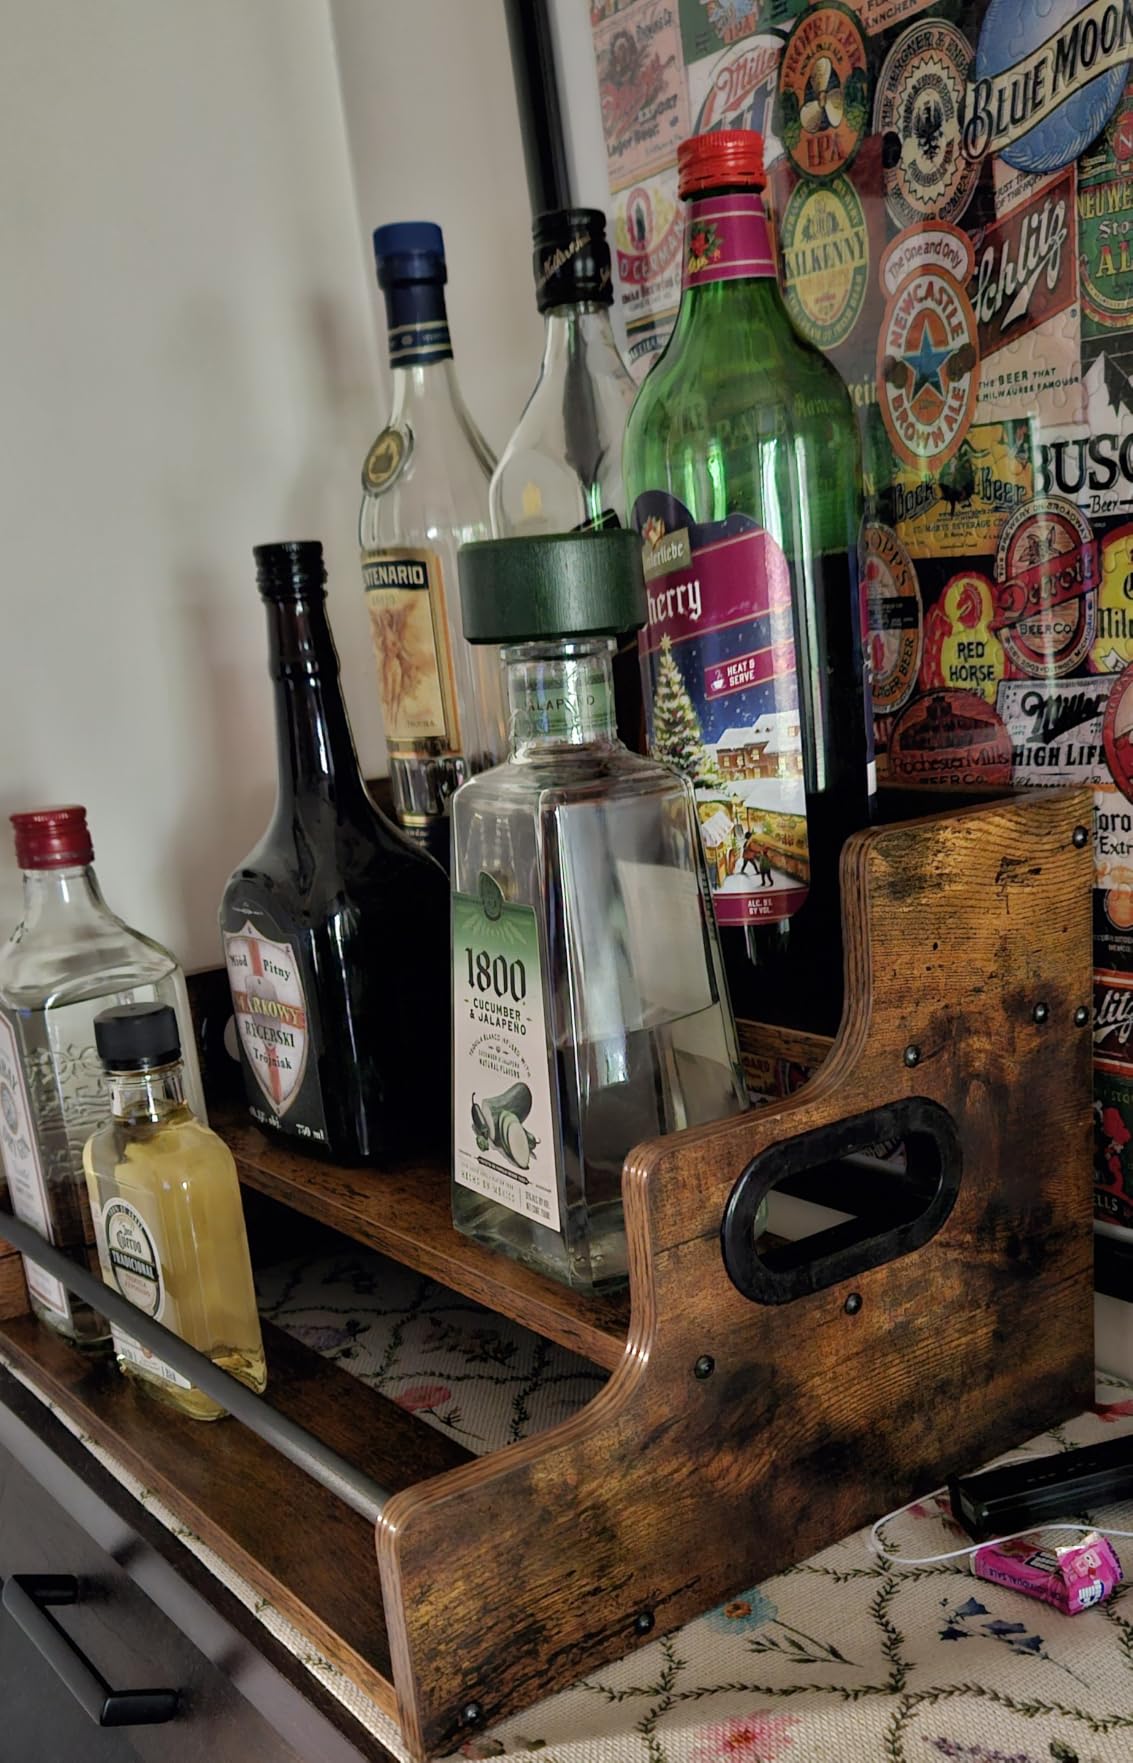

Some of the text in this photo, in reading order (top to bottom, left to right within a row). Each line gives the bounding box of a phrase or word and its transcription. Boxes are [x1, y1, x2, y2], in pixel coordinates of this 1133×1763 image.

[962, 56, 1047, 160] BLUE
[806, 133, 847, 168] IPA
[889, 238, 963, 279] The One and Only
[889, 281, 965, 348] NEWCASTLE
[998, 370, 1028, 386] BEER
[1033, 367, 1056, 379] THAT
[891, 385, 966, 449] BROWN ALE
[1089, 495, 1118, 514] Beer
[1047, 502, 1089, 542] BROADWAY
[365, 566, 424, 586] TENARIO
[647, 579, 703, 625] herry
[1019, 623, 1051, 635] BEER
[899, 636, 915, 677] BEER
[957, 641, 985, 663] RED
[727, 660, 747, 678] HEAT
[729, 671, 756, 688] SERVE
[950, 664, 995, 687] HORSE
[529, 695, 595, 712] ALAPO
[967, 750, 1009, 768] Mills
[1012, 744, 1061, 767] HIGH
[749, 907, 758, 915] BY
[263, 959, 291, 982] Pitny
[466, 947, 527, 1003] 1800
[469, 1009, 475, 1020] &
[473, 998, 521, 1021] CUCUMBER
[245, 1020, 296, 1048] RYCERSKI
[117, 1230, 142, 1254] Cuervo
[112, 1250, 155, 1280] TRADICIONAL
